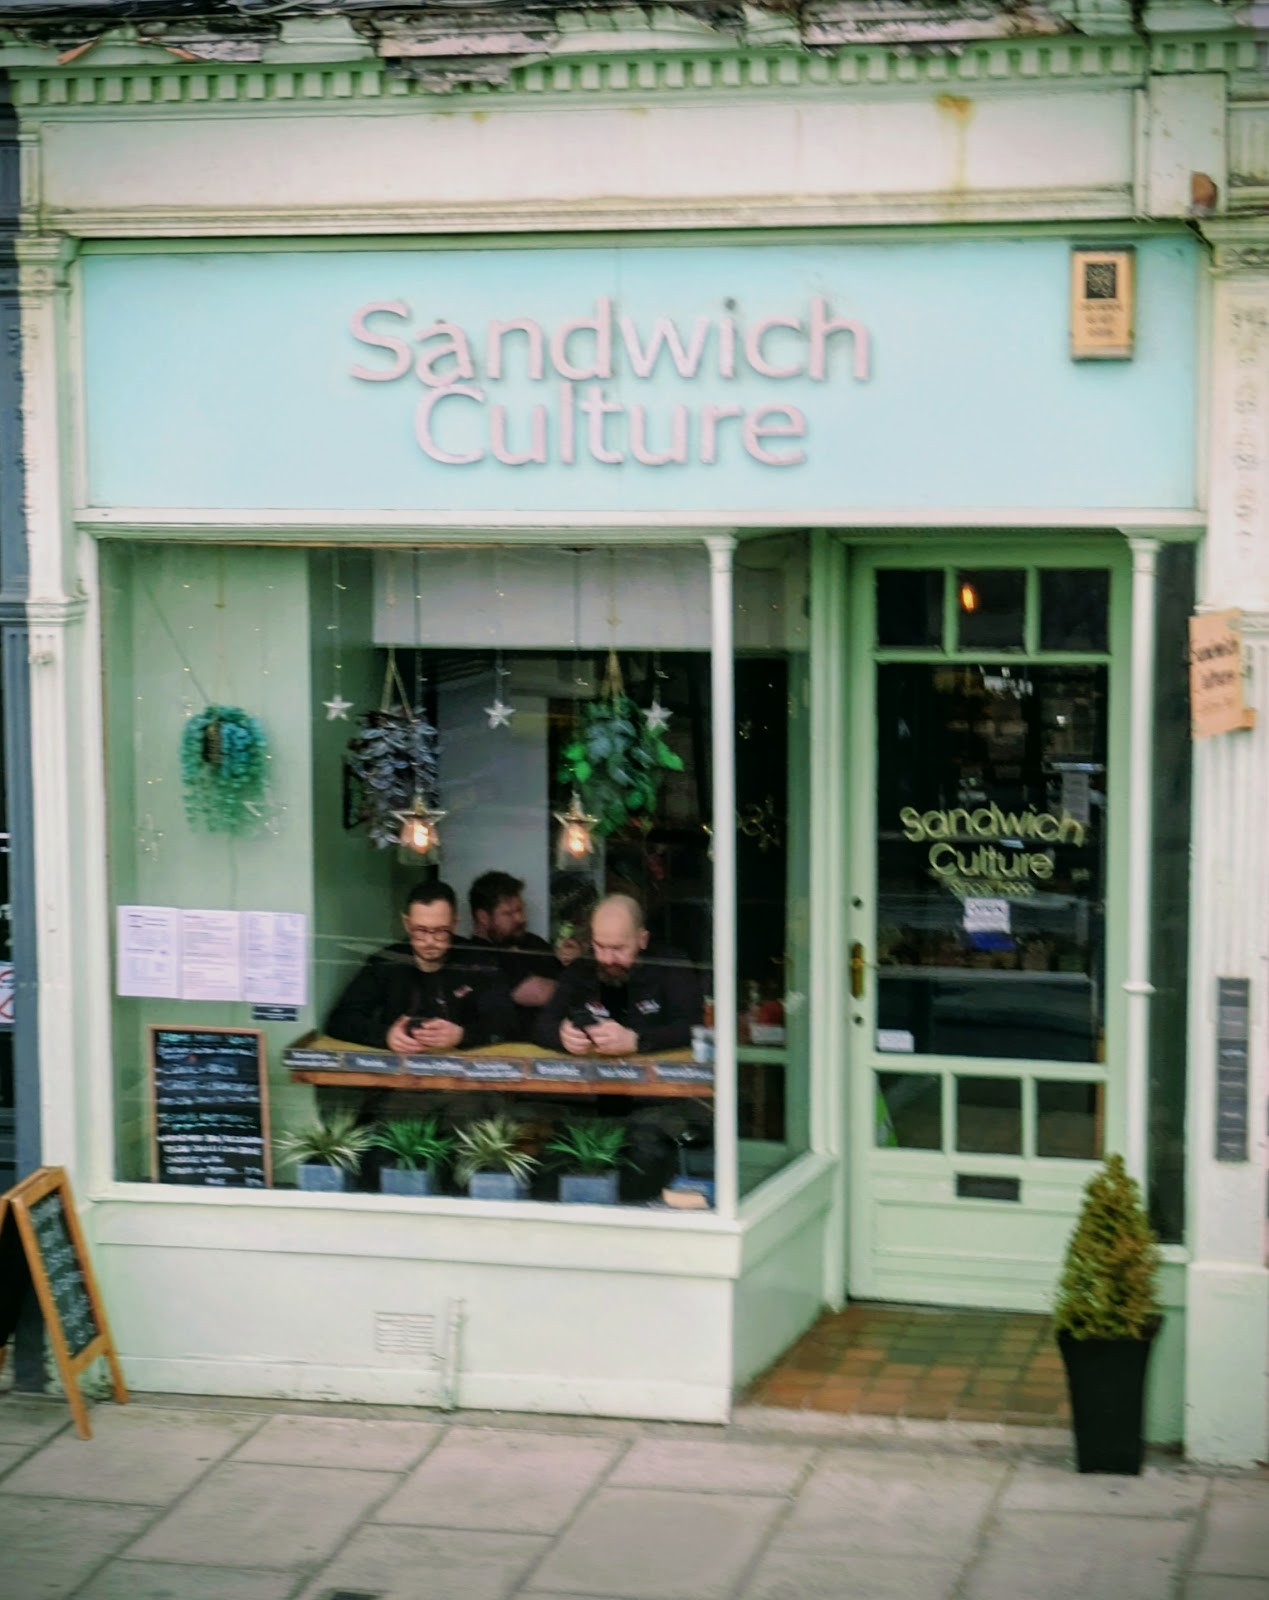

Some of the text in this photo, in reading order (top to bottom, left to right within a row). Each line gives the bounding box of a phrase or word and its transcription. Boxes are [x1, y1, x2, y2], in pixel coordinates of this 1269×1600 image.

[348, 296, 871, 388] Sandwich
[415, 381, 808, 466] Culture
[928, 842, 1055, 880] Culture
